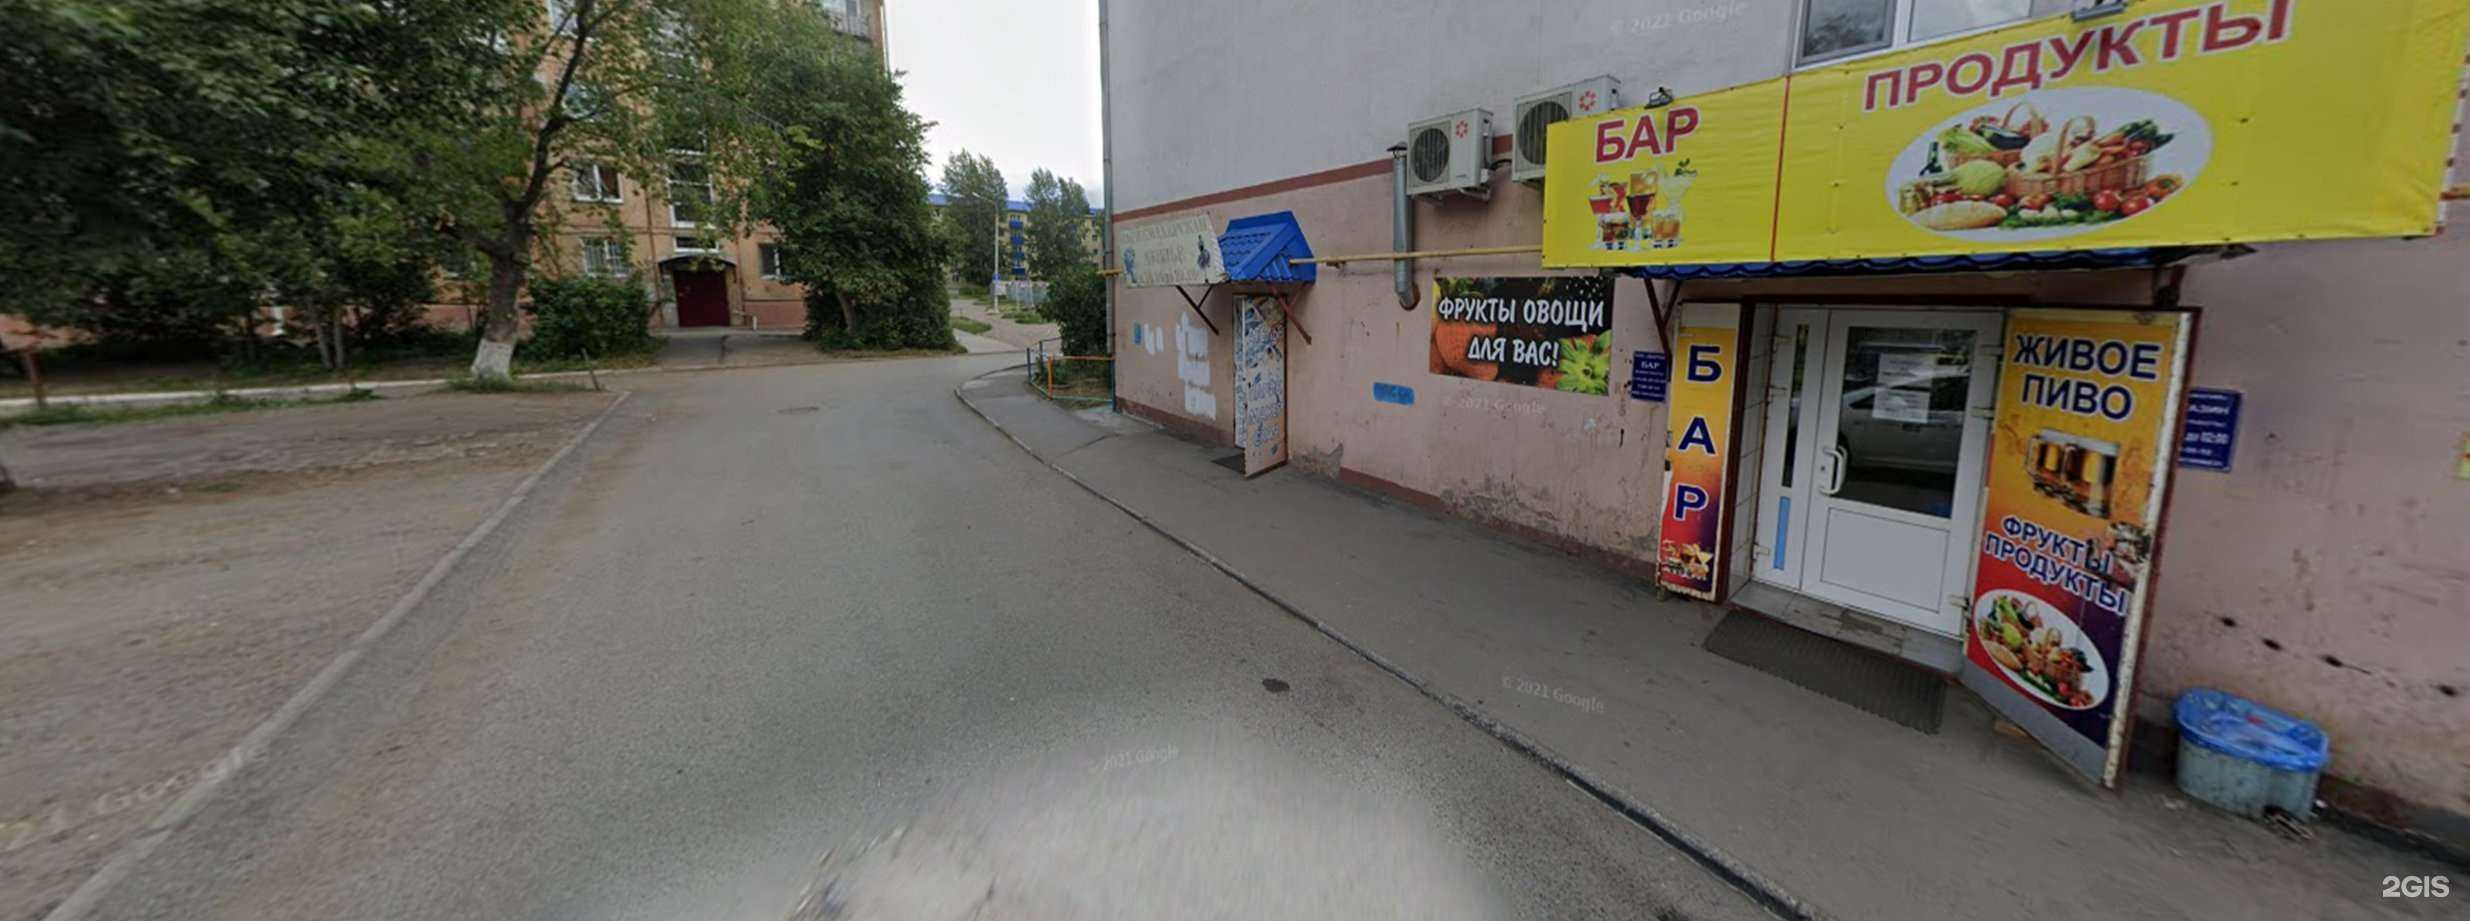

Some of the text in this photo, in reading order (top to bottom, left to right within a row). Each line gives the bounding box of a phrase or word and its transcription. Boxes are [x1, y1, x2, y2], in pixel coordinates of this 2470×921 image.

[1865, 0, 2288, 109] ПРОДУКТЫ
[1596, 108, 1699, 162] БАР
[1438, 297, 1604, 333] ФРУКТЫ ОВОЩИ
[1468, 337, 1560, 366] ДЛЯ ВАС!
[1641, 360, 1661, 369] БАР
[2013, 334, 2161, 380] ЖИВОЕ
[2022, 374, 2132, 420] ПИВО
[1672, 345, 1722, 519] БАР
[2003, 516, 2112, 574] ФРУКТЫ
[1986, 532, 2125, 612] ПРОДУКТЫ
